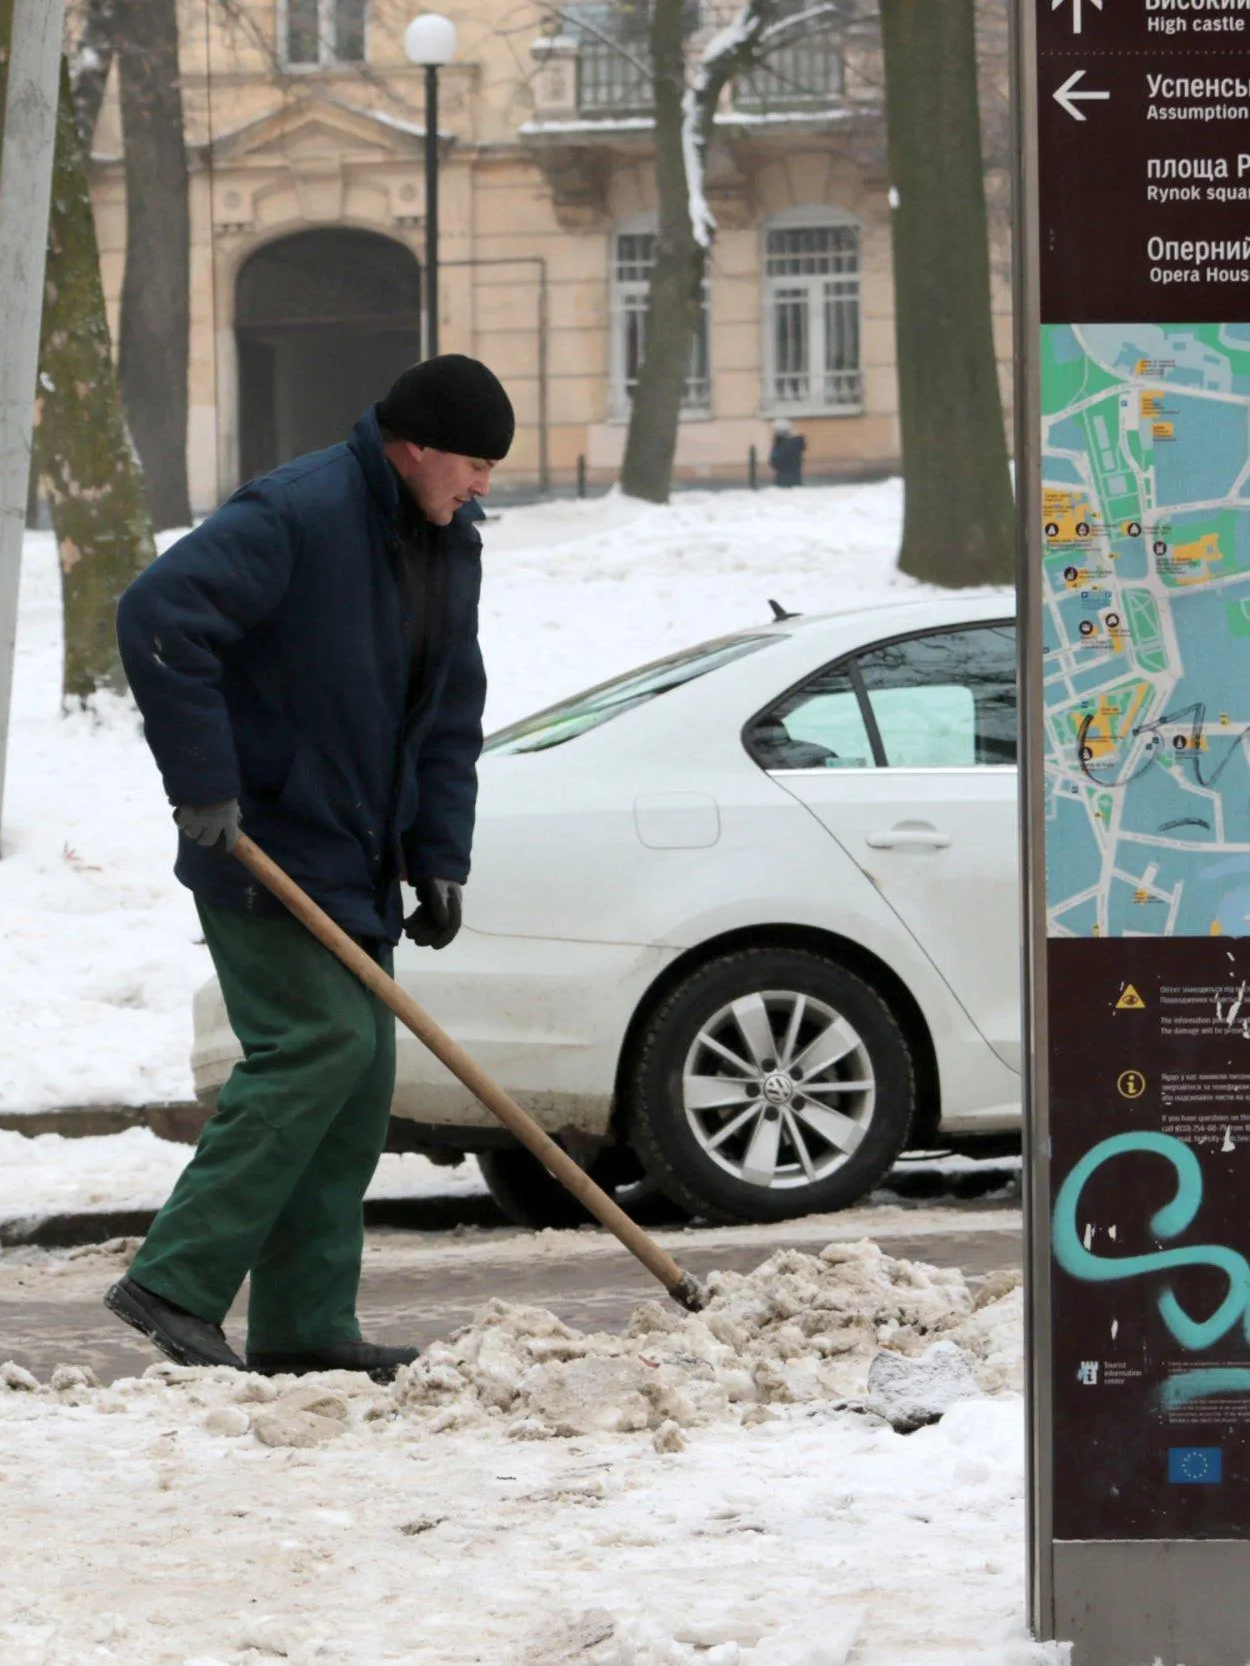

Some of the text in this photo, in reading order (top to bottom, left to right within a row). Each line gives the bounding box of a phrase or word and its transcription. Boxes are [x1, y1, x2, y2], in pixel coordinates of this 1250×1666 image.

[1147, 17, 1245, 34] High castle
[1146, 73, 1250, 98] Успенсь
[1146, 105, 1248, 122] Assumption
[1147, 158, 1228, 181] площа
[1147, 186, 1201, 203] Rynok
[1147, 236, 1250, 265] Оперний
[1150, 267, 1250, 285] Opera Hous
